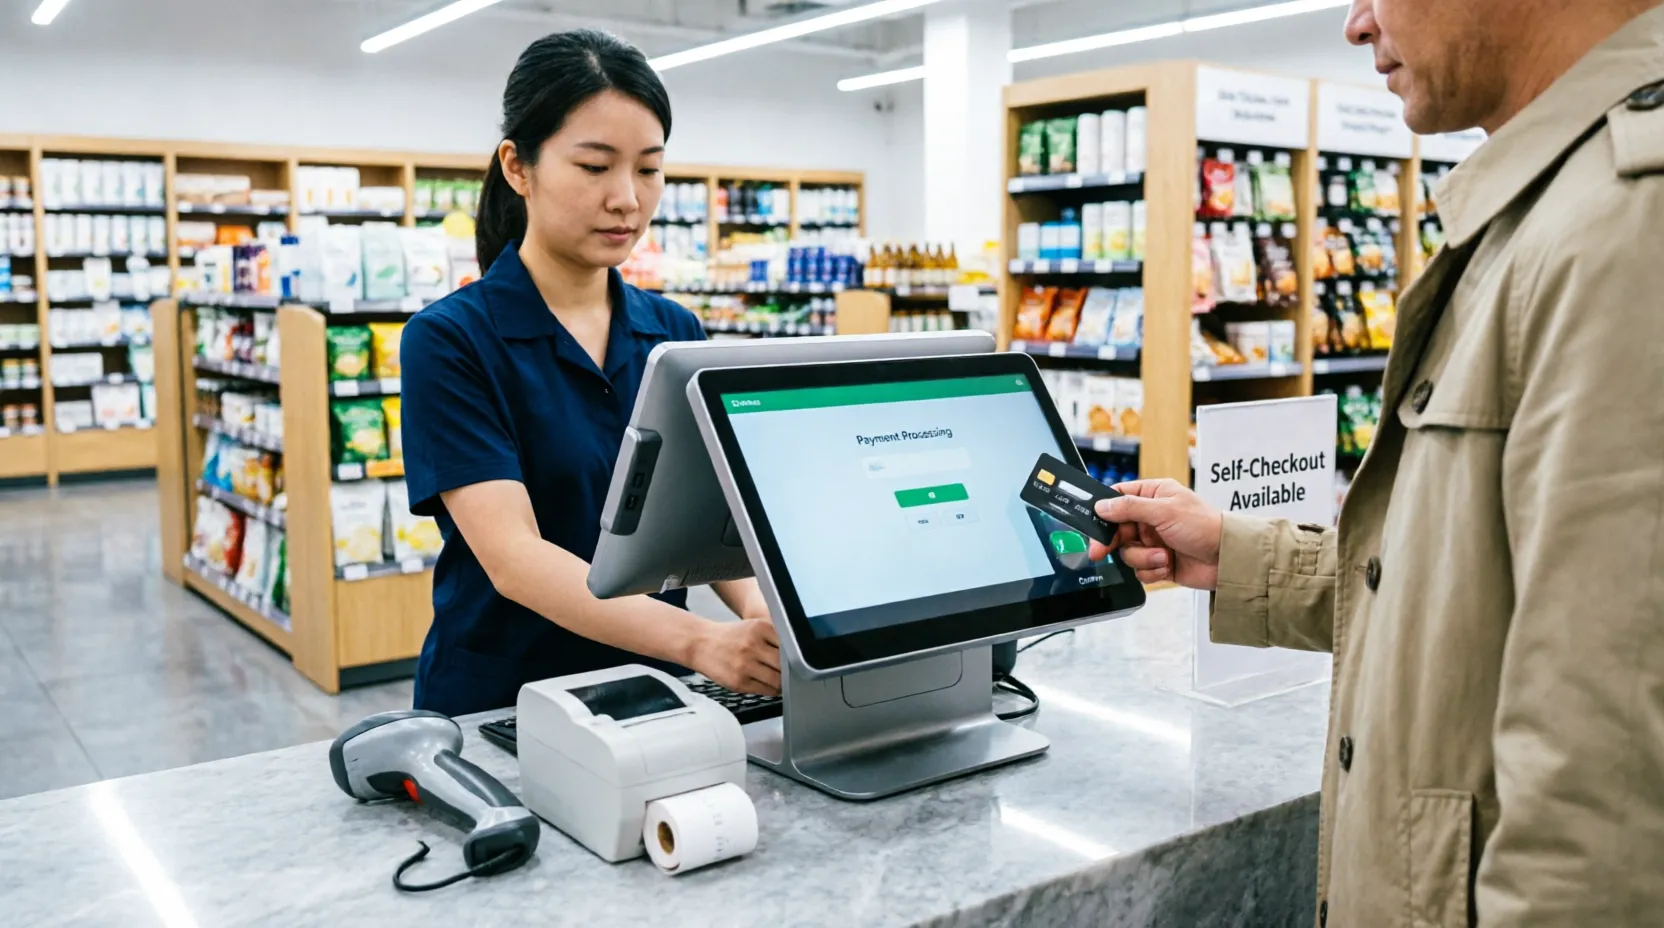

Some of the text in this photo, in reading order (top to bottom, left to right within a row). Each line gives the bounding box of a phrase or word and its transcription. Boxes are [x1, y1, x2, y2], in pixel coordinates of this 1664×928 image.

[856, 432, 901, 446] Payment
[1210, 451, 1326, 483] Self-Checkout
[1229, 481, 1306, 511] Available
